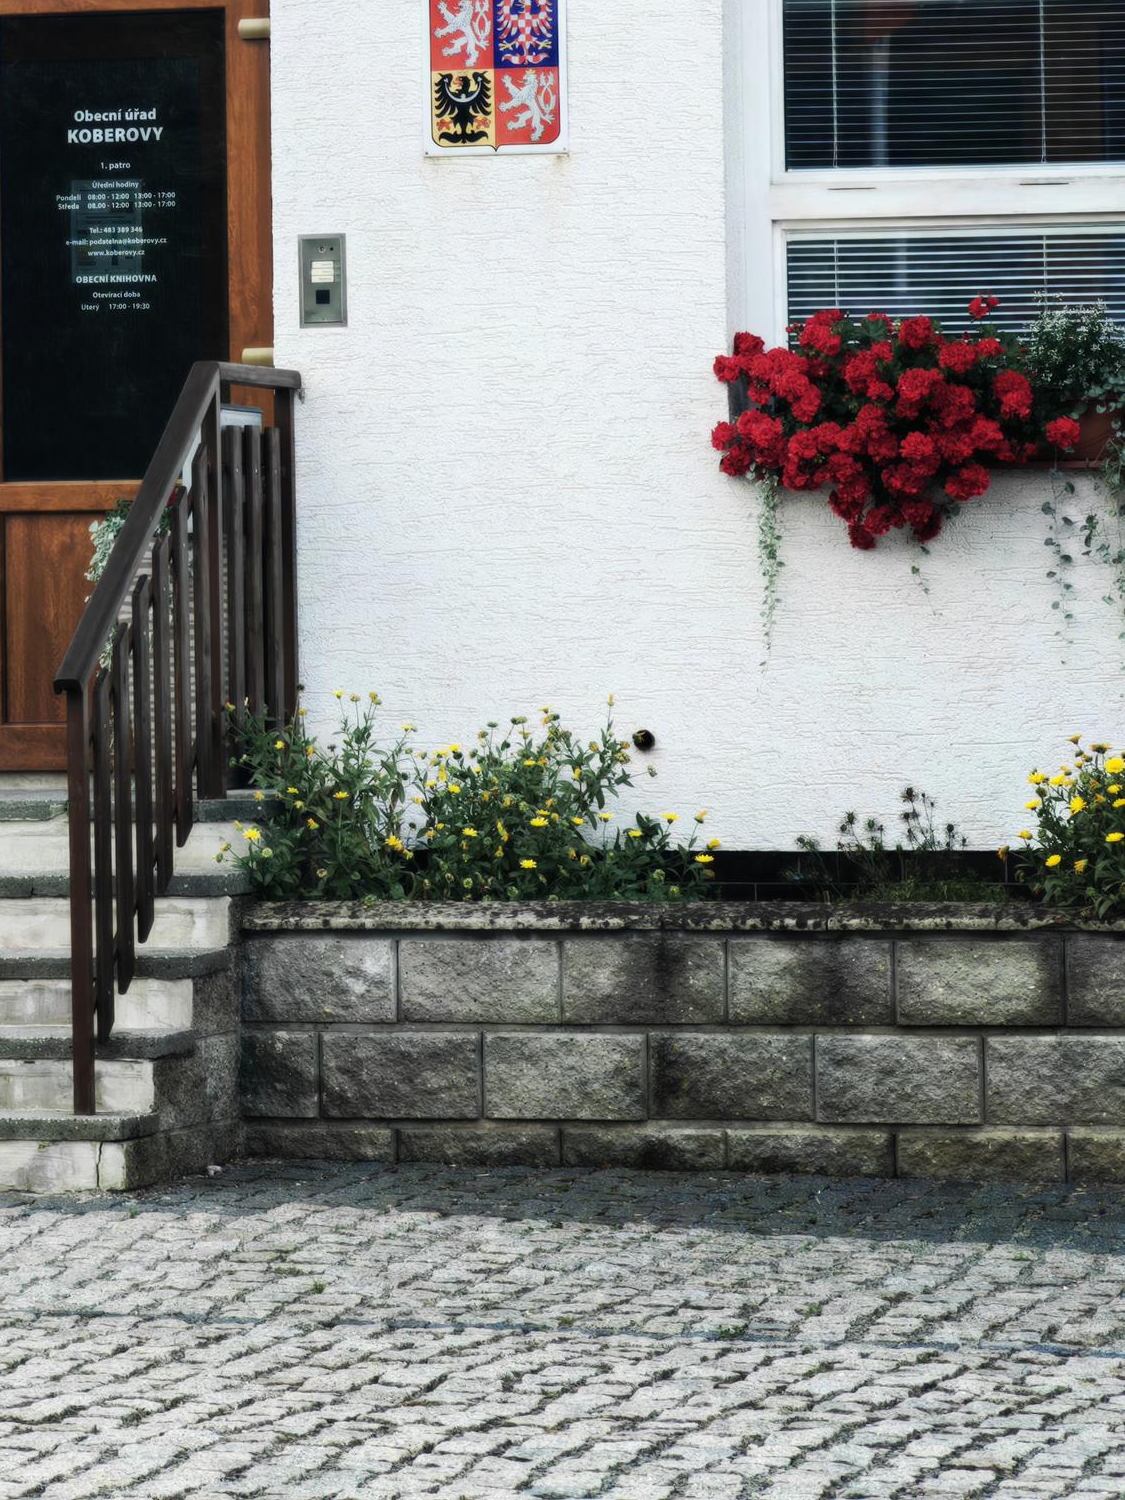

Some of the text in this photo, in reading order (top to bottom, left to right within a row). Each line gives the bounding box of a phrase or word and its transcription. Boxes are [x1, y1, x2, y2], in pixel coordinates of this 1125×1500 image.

[74, 108, 157, 123] Obecní úřad
[67, 126, 164, 144] KOBEROVY
[100, 161, 131, 171] 1. patro
[115, 180, 139, 189] hodiny
[111, 192, 130, 200] 12:00
[157, 191, 176, 199] 17:00
[111, 201, 130, 209] 12:00
[157, 200, 176, 208] 17:00
[87, 249, 146, 257] www.koberovy.cz
[75, 273, 157, 284] OBECNÍ KNIHOVNA
[123, 290, 141, 298] doba
[132, 302, 150, 310] 19:30
